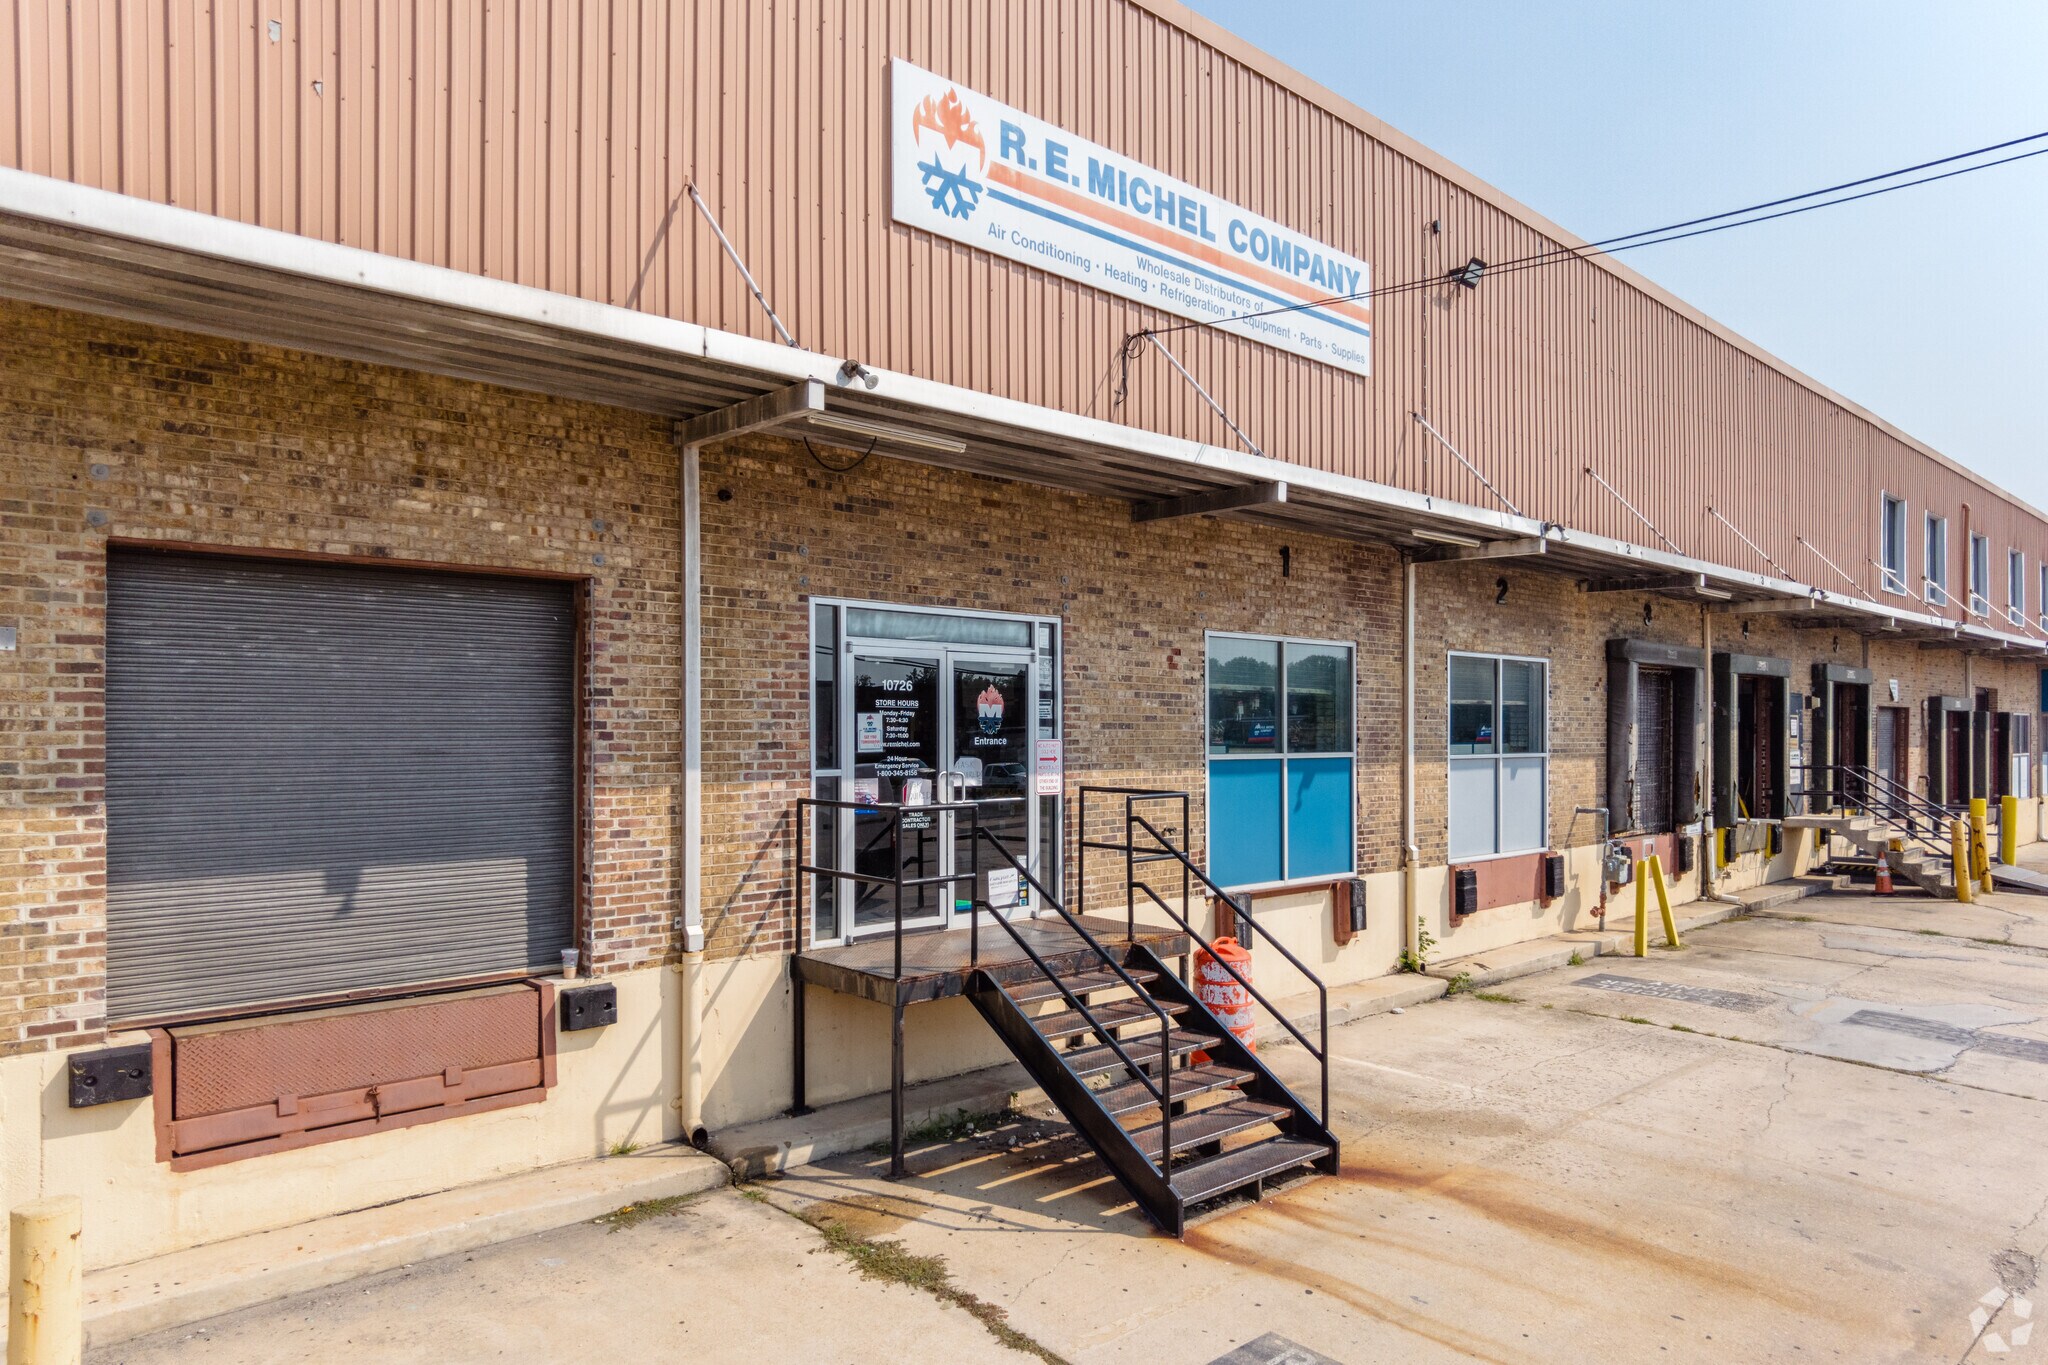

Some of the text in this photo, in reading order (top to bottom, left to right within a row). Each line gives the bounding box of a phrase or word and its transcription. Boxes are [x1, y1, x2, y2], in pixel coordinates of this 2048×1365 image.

[1000, 119, 1361, 299] R. E. MICHEL COMPANY
[987, 222, 1365, 365] Air Conditioning Heating Refrigeration Equipment Parts Supplies
[1137, 255, 1264, 313] Wholesale Distributors of
[1279, 545, 1290, 578] 1
[1496, 576, 1508, 606] 2
[881, 679, 913, 692] 10726
[875, 699, 896, 707] STORE
[874, 740, 921, 748] w.remichel.com
[974, 736, 1007, 746] Entrance
